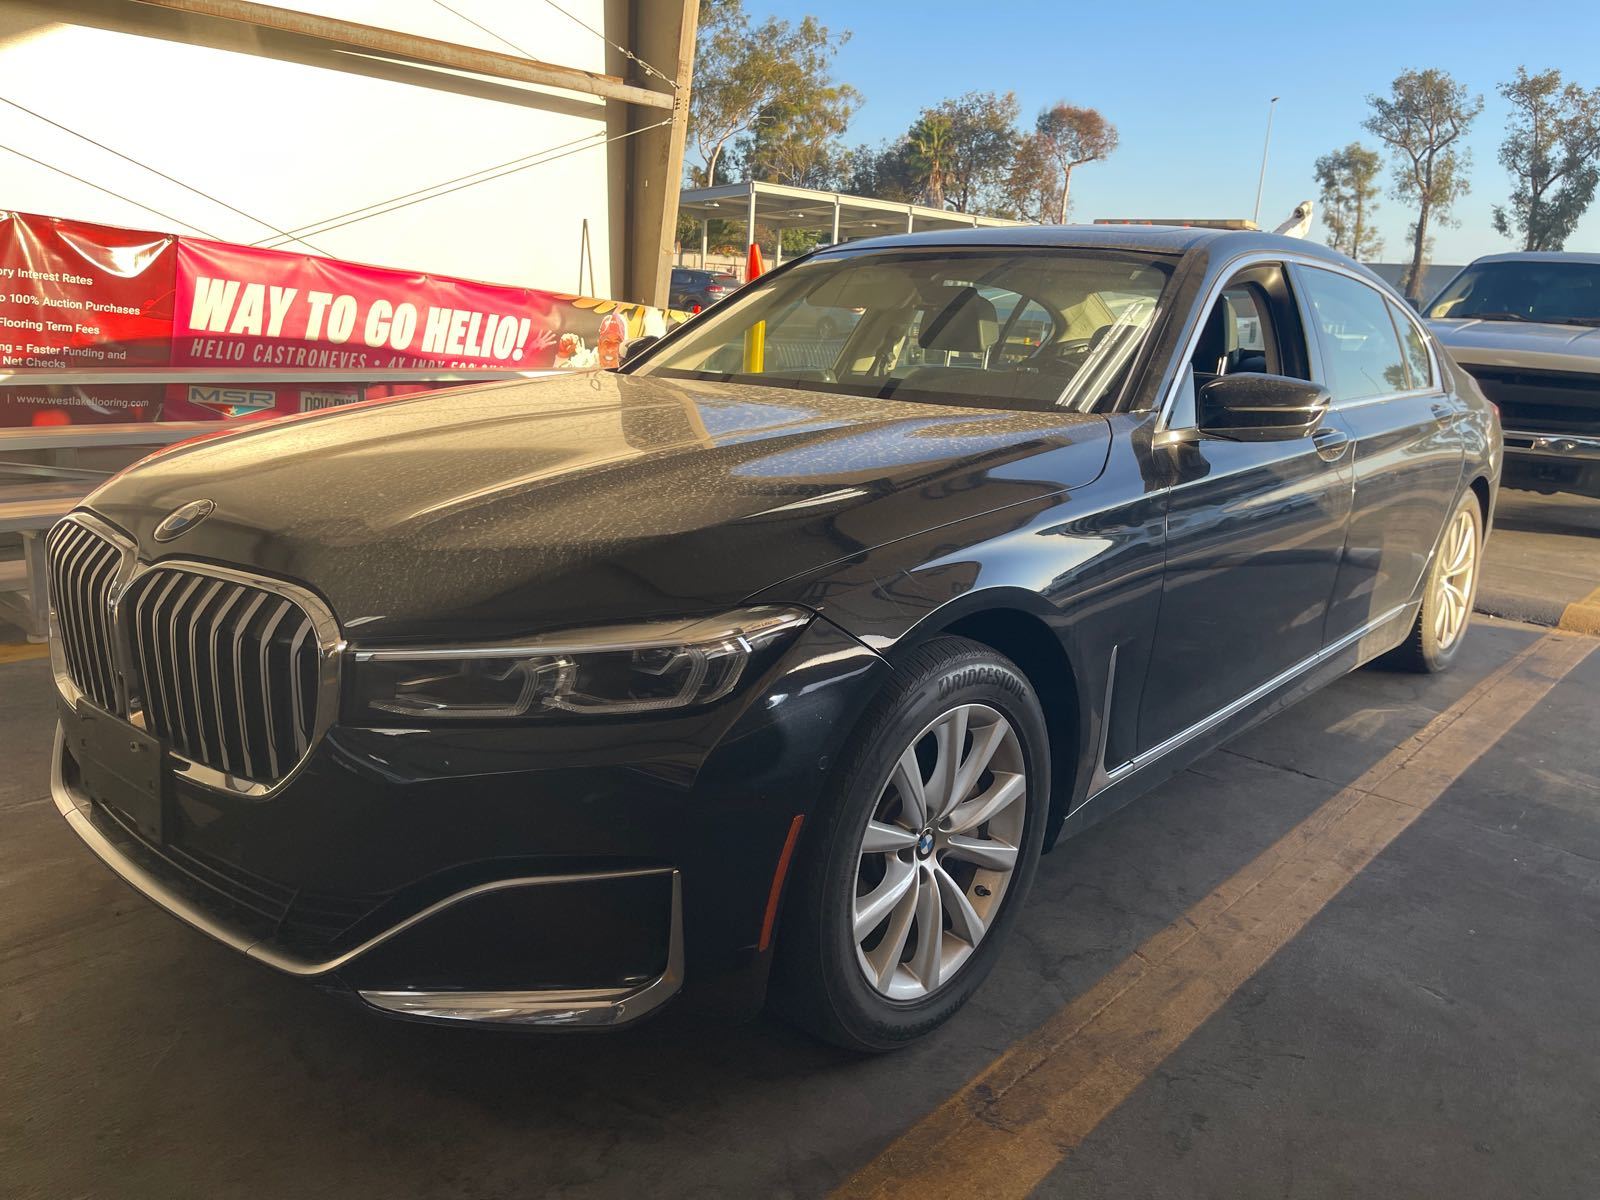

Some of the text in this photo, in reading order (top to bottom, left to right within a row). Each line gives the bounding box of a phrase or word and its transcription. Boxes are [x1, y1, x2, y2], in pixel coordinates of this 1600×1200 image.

[18, 268, 59, 282] Interest
[62, 273, 93, 286] Rates
[10, 294, 39, 305] 100%
[42, 296, 82, 310] Auction
[85, 301, 141, 315] Purchases
[188, 276, 531, 361] WAY TO GO HELIO!
[45, 320, 72, 333] Term
[75, 323, 100, 335] Fees
[26, 344, 60, 355] Faster
[63, 346, 104, 360] Funding
[107, 351, 126, 360] and
[190, 338, 246, 361] HELIO
[253, 343, 367, 368] CASTRONEVES
[2, 355, 66, 368] Net Checks
[16, 395, 149, 408] www.westlakeflooring.com
[191, 387, 273, 404] MSR
[938, 666, 1026, 702] BRIDGESTONE
